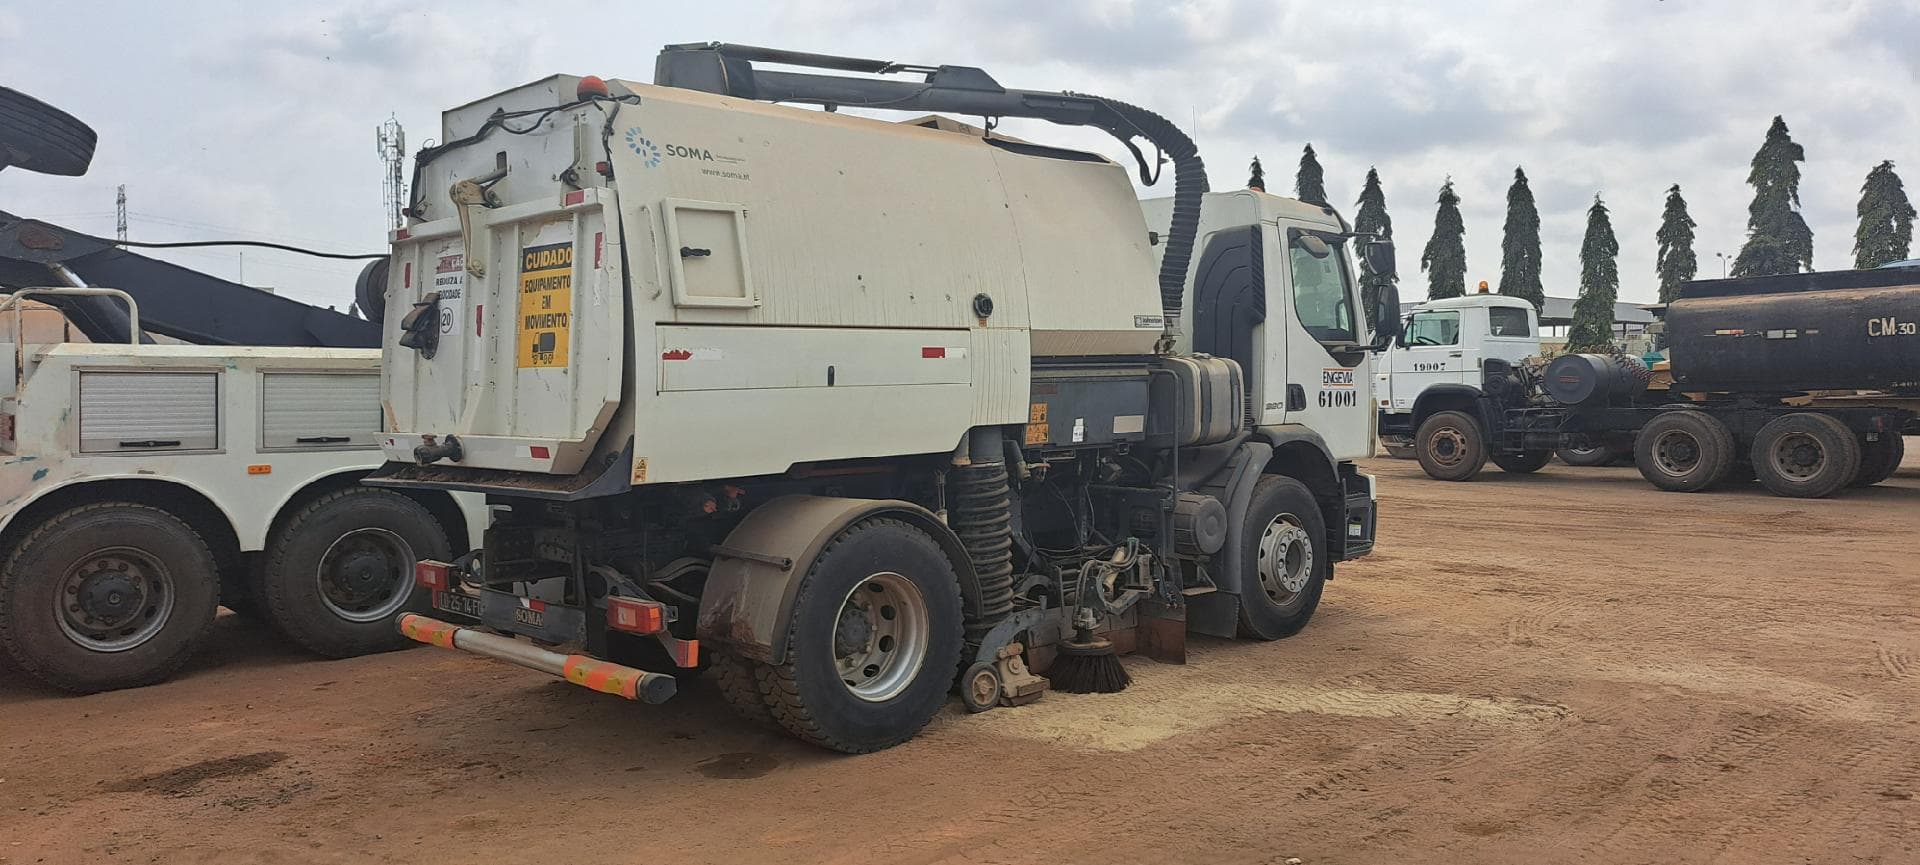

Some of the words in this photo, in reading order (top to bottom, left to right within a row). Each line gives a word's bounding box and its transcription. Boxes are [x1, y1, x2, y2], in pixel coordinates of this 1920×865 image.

[665, 144, 714, 162] SOMA
[526, 247, 572, 270] CUIDADO
[436, 277, 457, 286] REDUZA
[525, 275, 571, 293] EQUIPAMENTO
[542, 295, 551, 309] EM
[442, 313, 451, 326] 20
[525, 312, 568, 330] MOVIMENTO
[1413, 362, 1446, 371] 19007
[1323, 371, 1353, 384] ENGEVIA
[1318, 391, 1357, 408] 61001
[516, 608, 543, 626] SOMA
